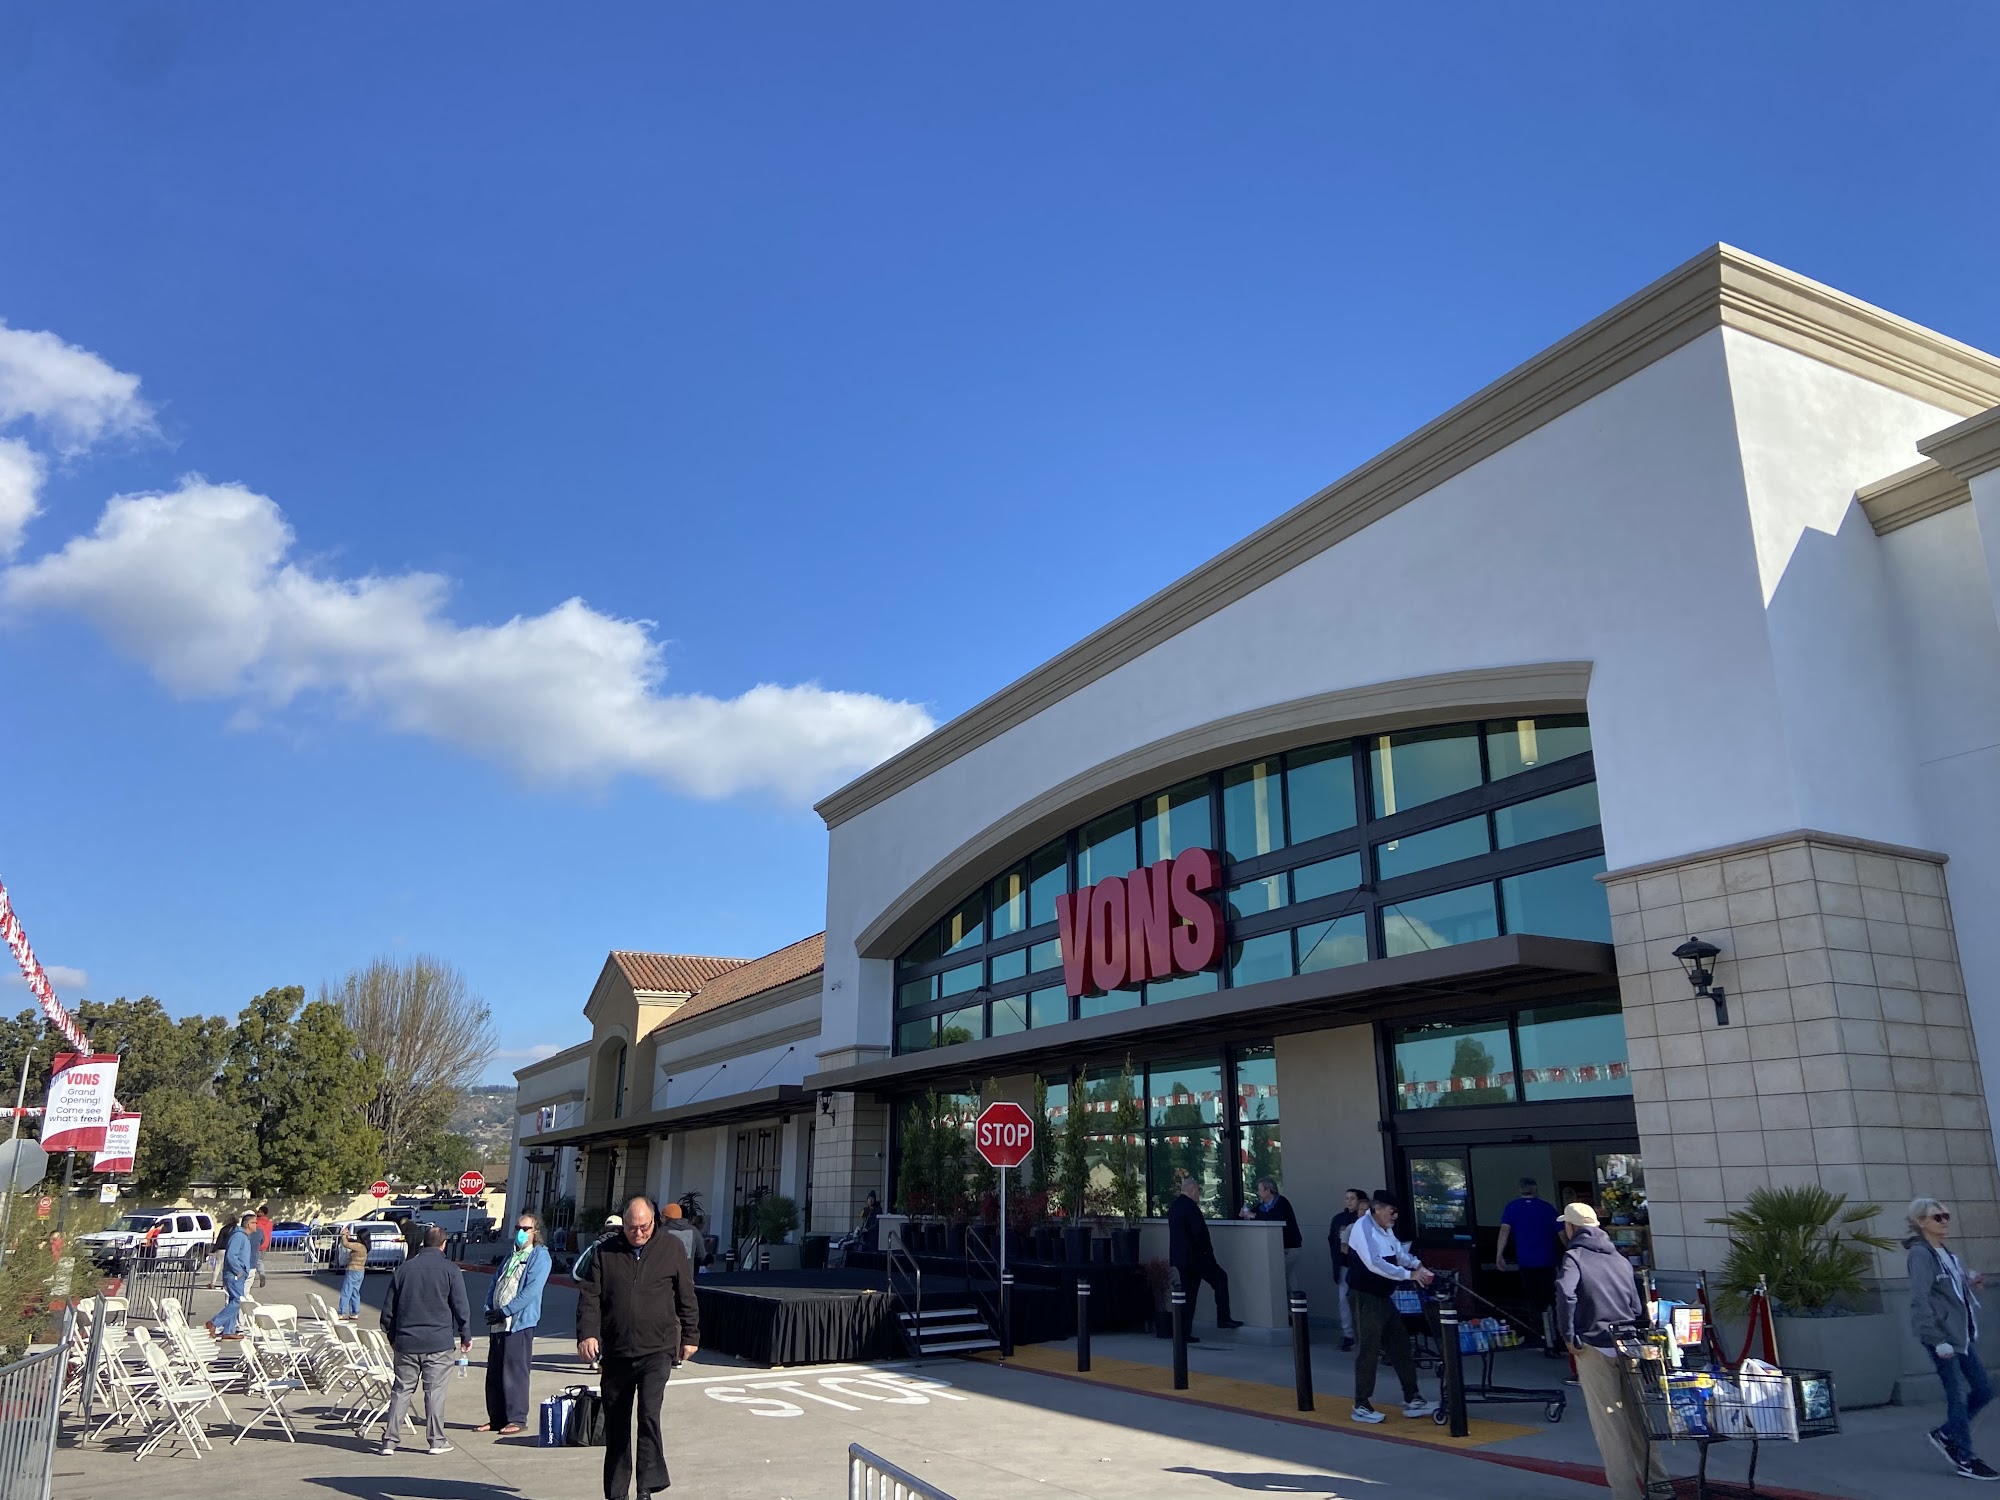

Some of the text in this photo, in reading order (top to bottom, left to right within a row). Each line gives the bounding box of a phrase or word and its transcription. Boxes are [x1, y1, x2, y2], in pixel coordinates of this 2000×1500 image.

[1056, 847, 1222, 997] VONS
[67, 1073, 100, 1085] VONS
[60, 1096, 101, 1106] Opening!
[56, 1106, 102, 1115] Come see
[980, 1122, 1030, 1147] STOP
[460, 1179, 483, 1189] STOP
[704, 1372, 968, 1418] STOP
